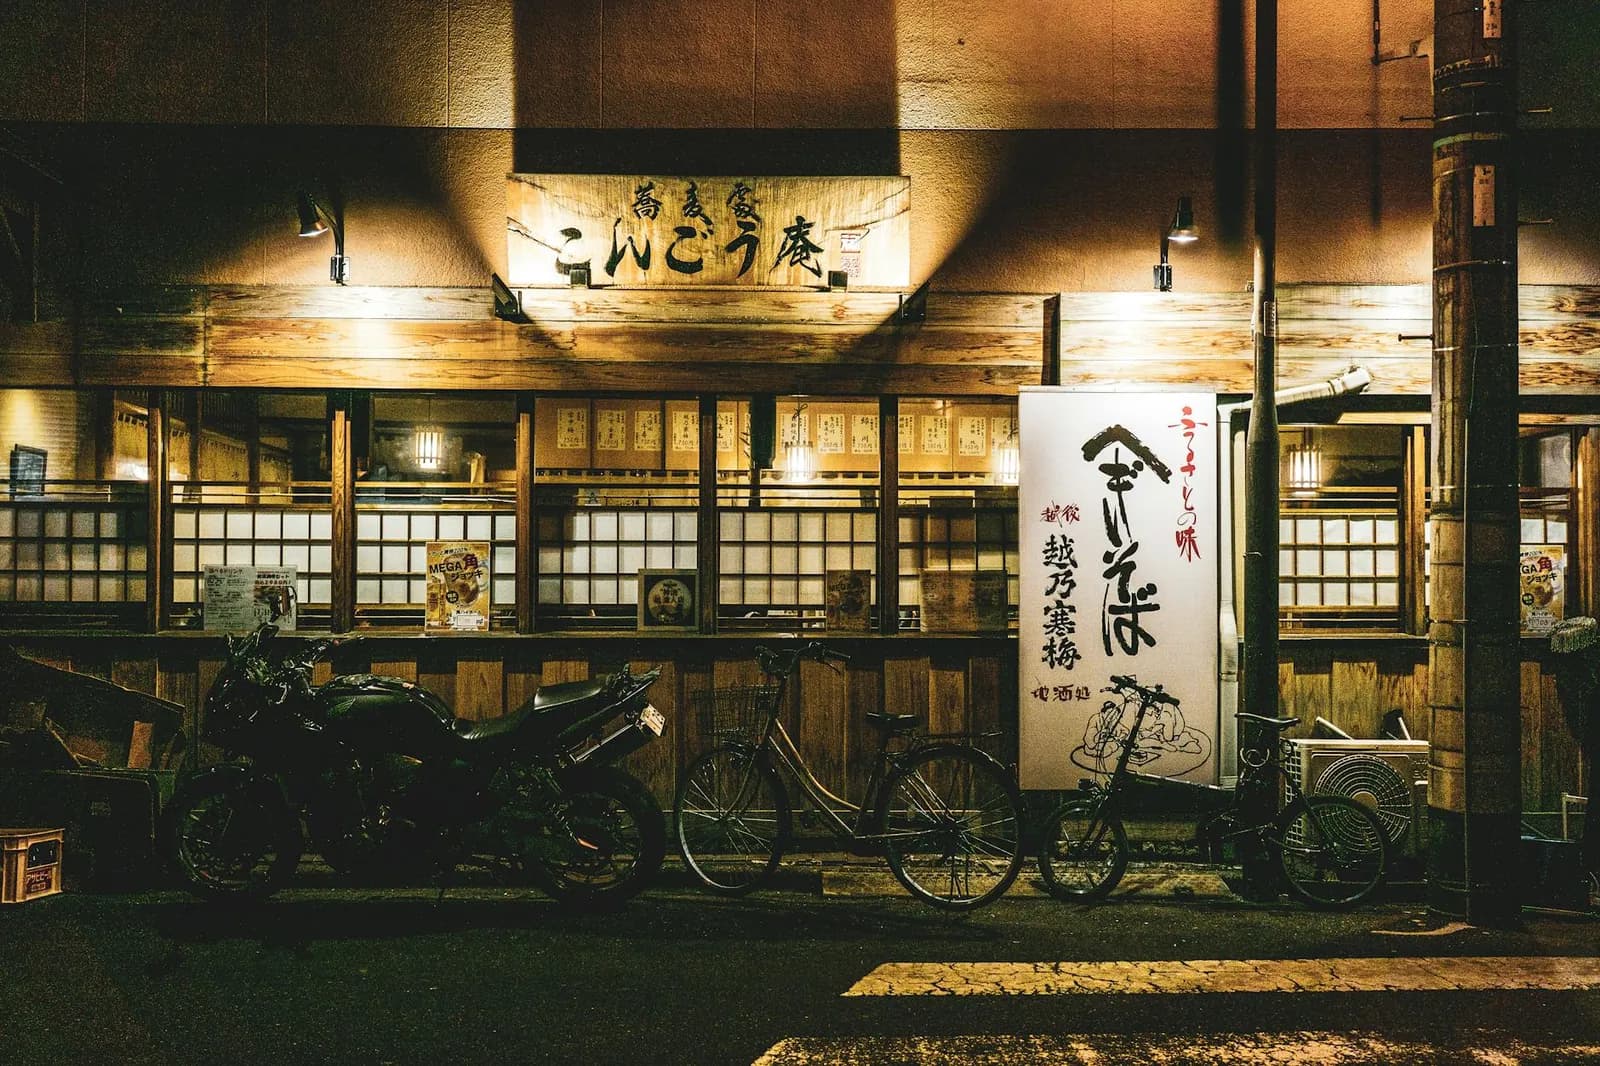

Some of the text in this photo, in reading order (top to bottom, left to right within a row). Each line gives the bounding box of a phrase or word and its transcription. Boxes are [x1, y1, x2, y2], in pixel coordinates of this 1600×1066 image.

[556, 216, 825, 278] こんごう庵
[1168, 406, 1208, 562] ふるさとの味
[1040, 502, 1081, 528] 越後
[1520, 563, 1538, 575] GA
[1042, 534, 1082, 670] 越乃寒梅
[1031, 683, 1091, 702] 地酒処
